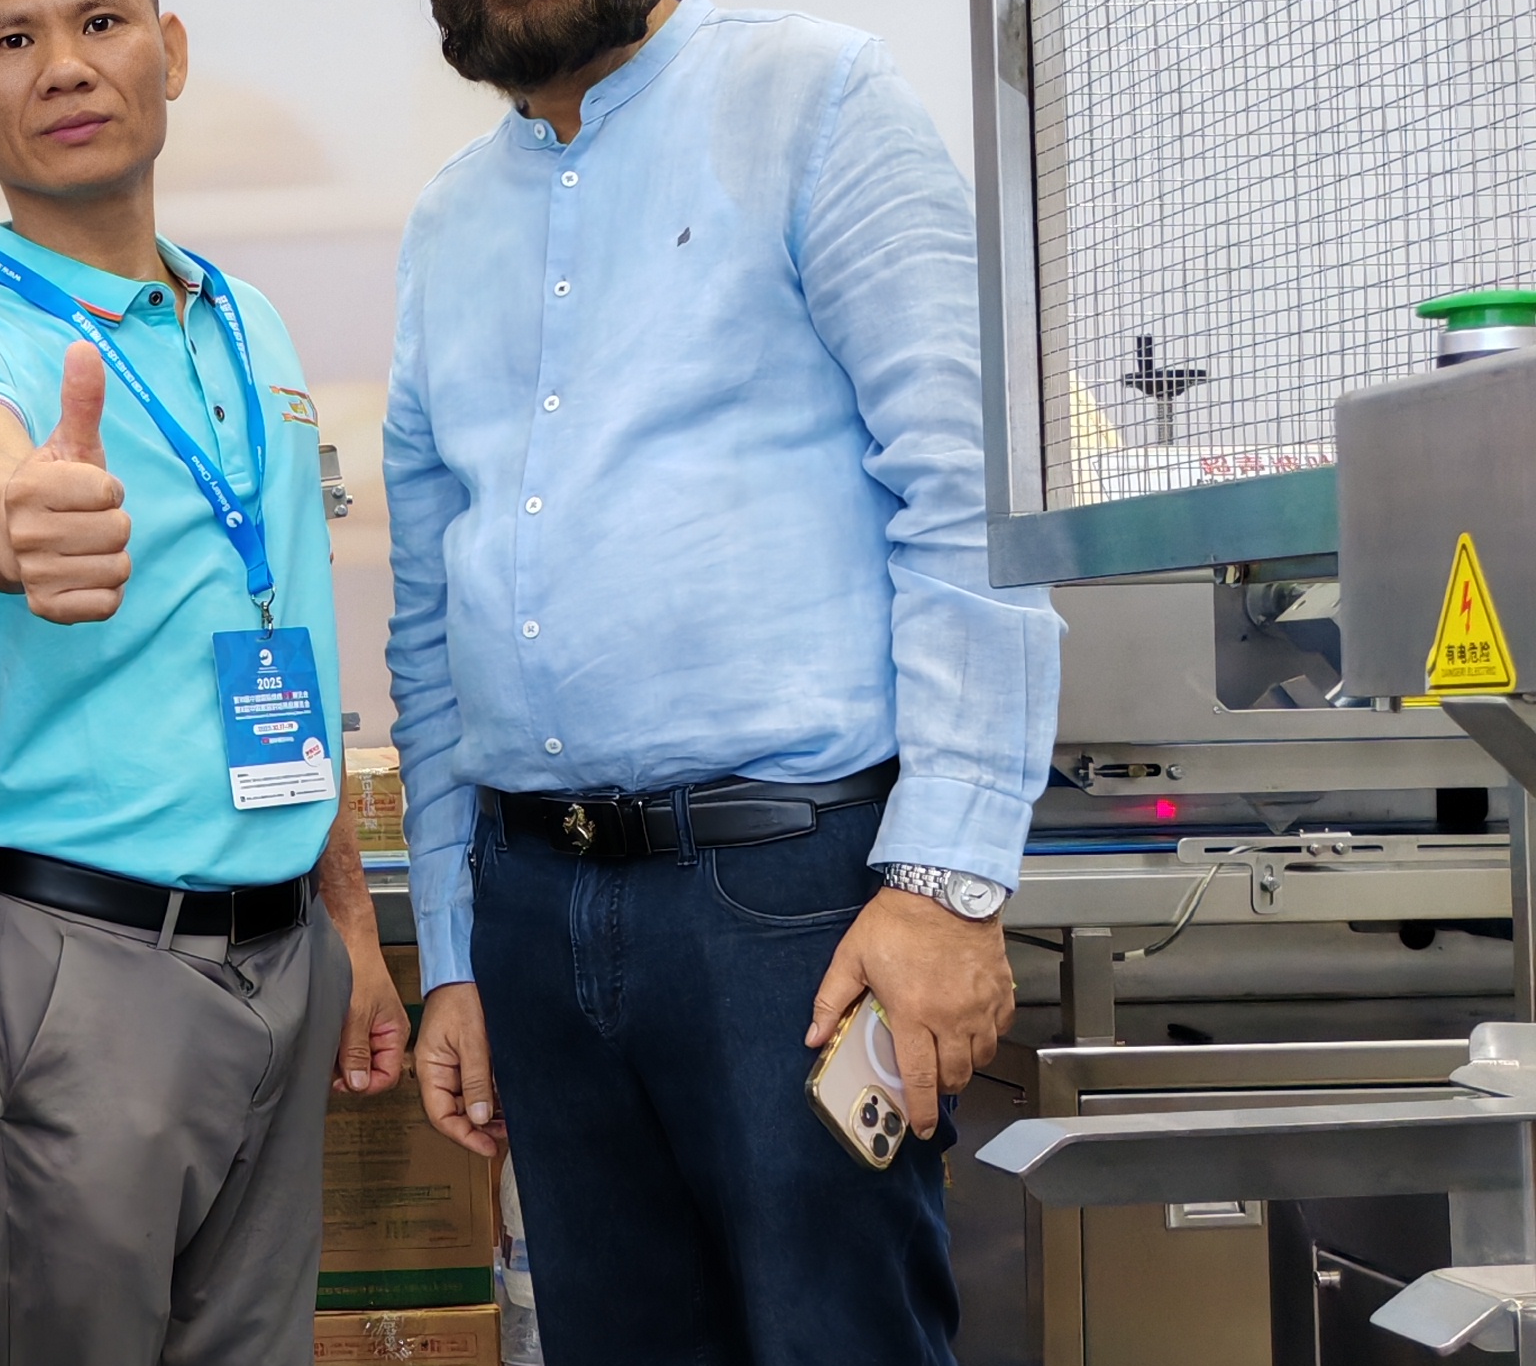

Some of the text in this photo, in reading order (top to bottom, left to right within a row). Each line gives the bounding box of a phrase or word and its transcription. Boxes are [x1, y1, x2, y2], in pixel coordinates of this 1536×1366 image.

[191, 454, 232, 512] Bakery China
[1445, 641, 1490, 665] 有电危险
[256, 677, 283, 690] 2025
